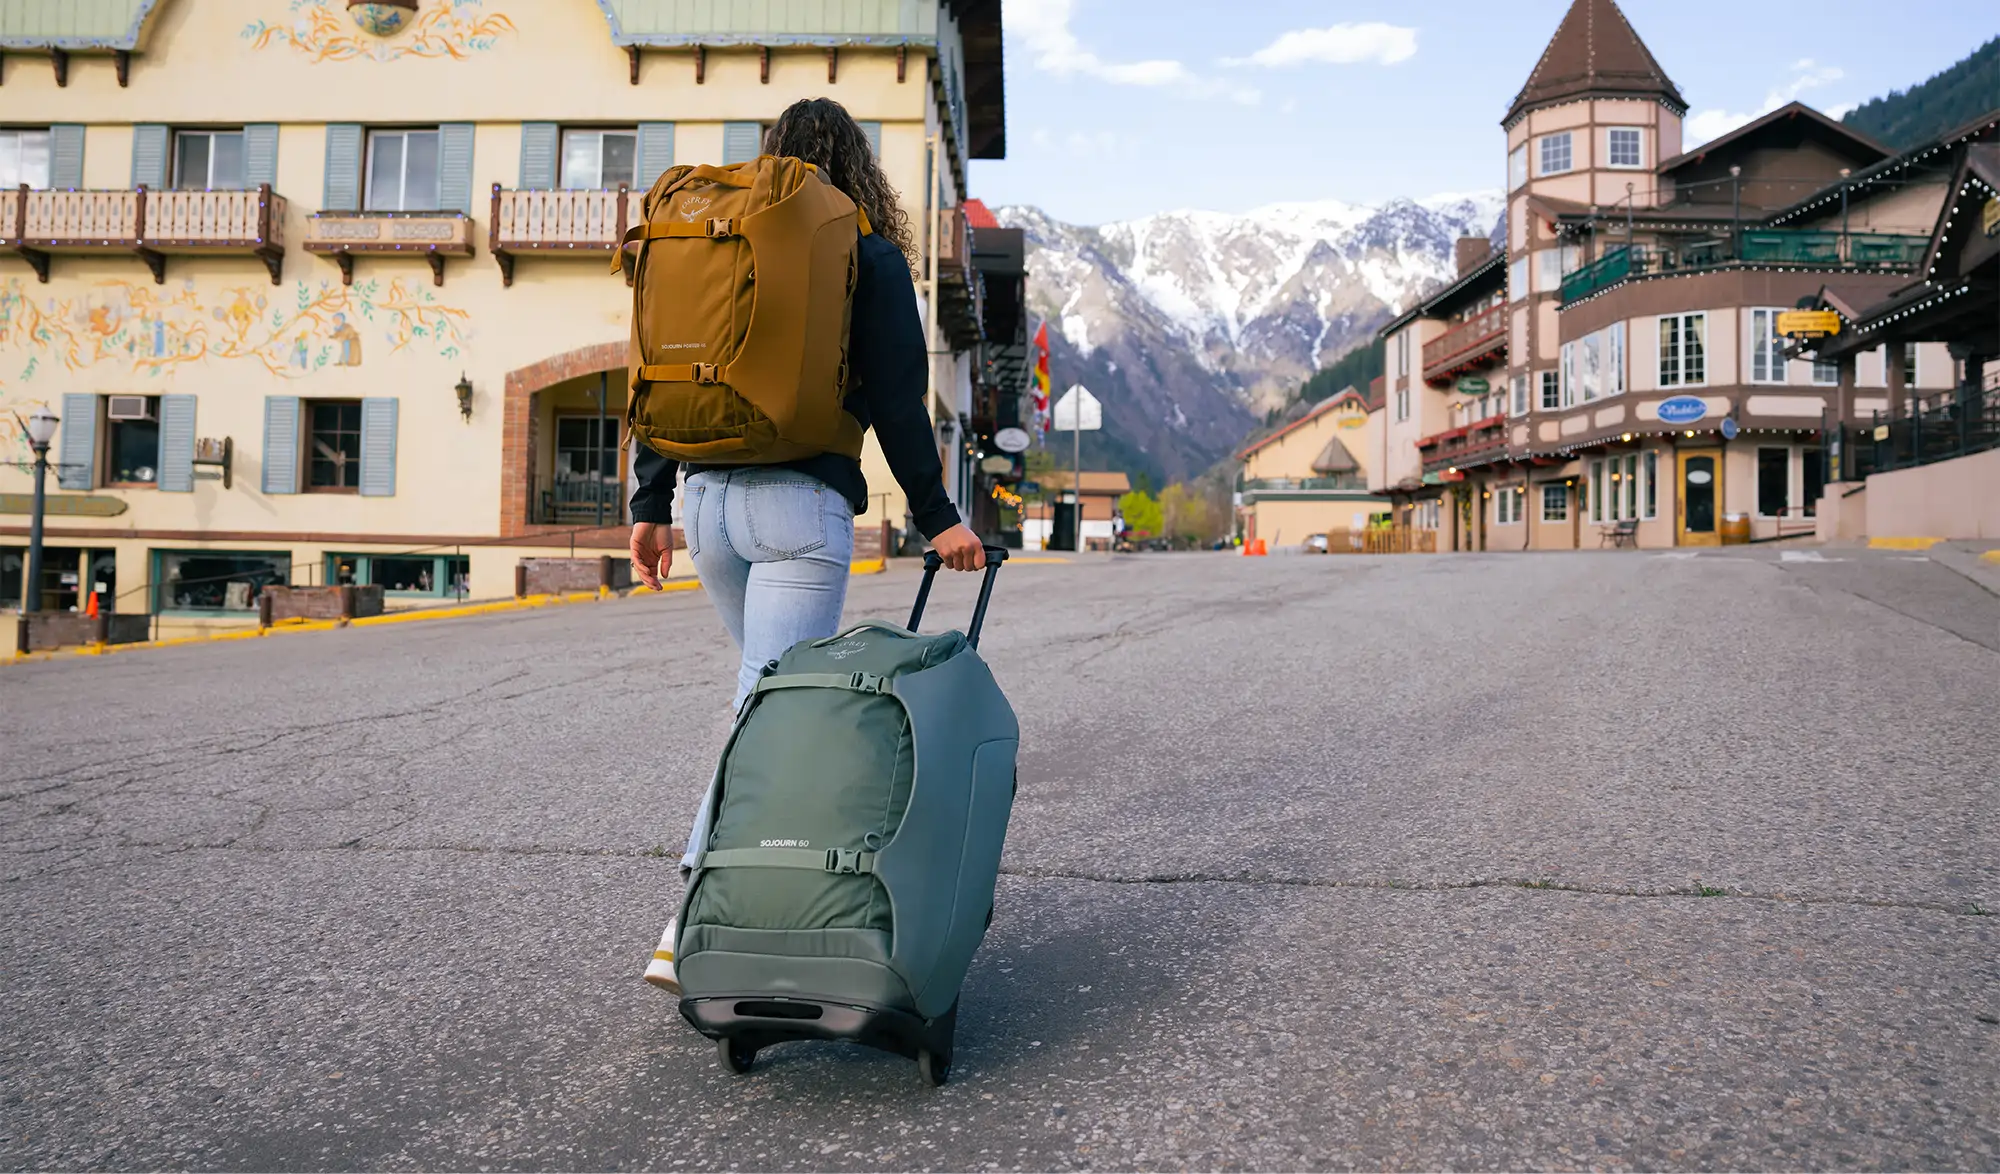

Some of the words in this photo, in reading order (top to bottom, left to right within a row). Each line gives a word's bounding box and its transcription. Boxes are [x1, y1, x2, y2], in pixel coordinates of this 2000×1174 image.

[682, 196, 712, 209] OSPREY
[760, 839, 797, 847] SOJOURN
[798, 839, 810, 847] 60
